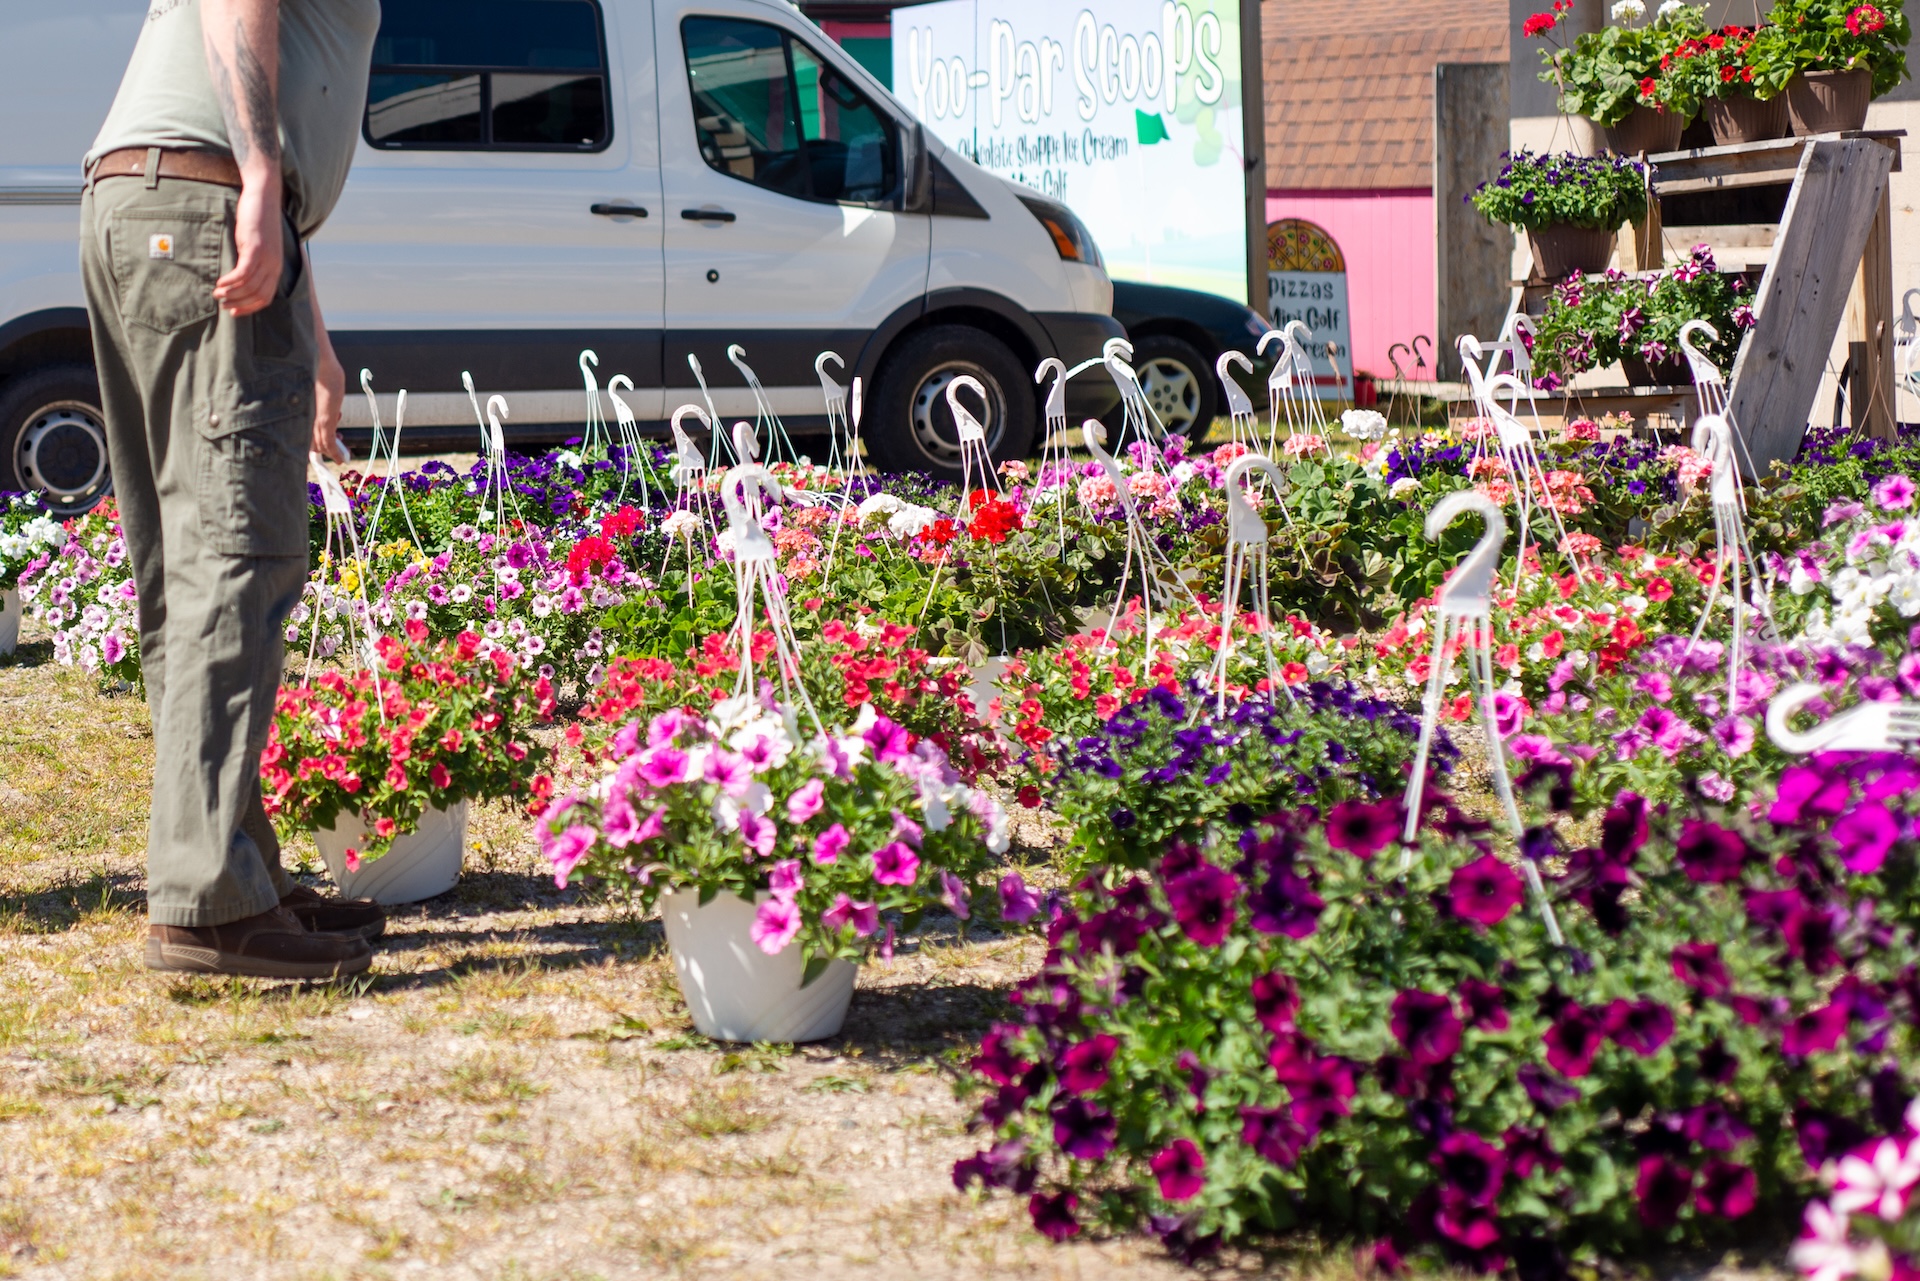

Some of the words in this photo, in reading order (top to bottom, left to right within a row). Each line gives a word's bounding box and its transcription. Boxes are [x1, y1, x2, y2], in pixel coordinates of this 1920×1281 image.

[908, 18, 1064, 129] Yoo-Par
[957, 135, 1014, 170] Chcolate
[1063, 130, 1080, 164] Ice
[1082, 128, 1129, 166] Cream
[1268, 277, 1334, 299] Pizzas
[1307, 306, 1341, 331] Golf
[1295, 336, 1346, 359] ream
